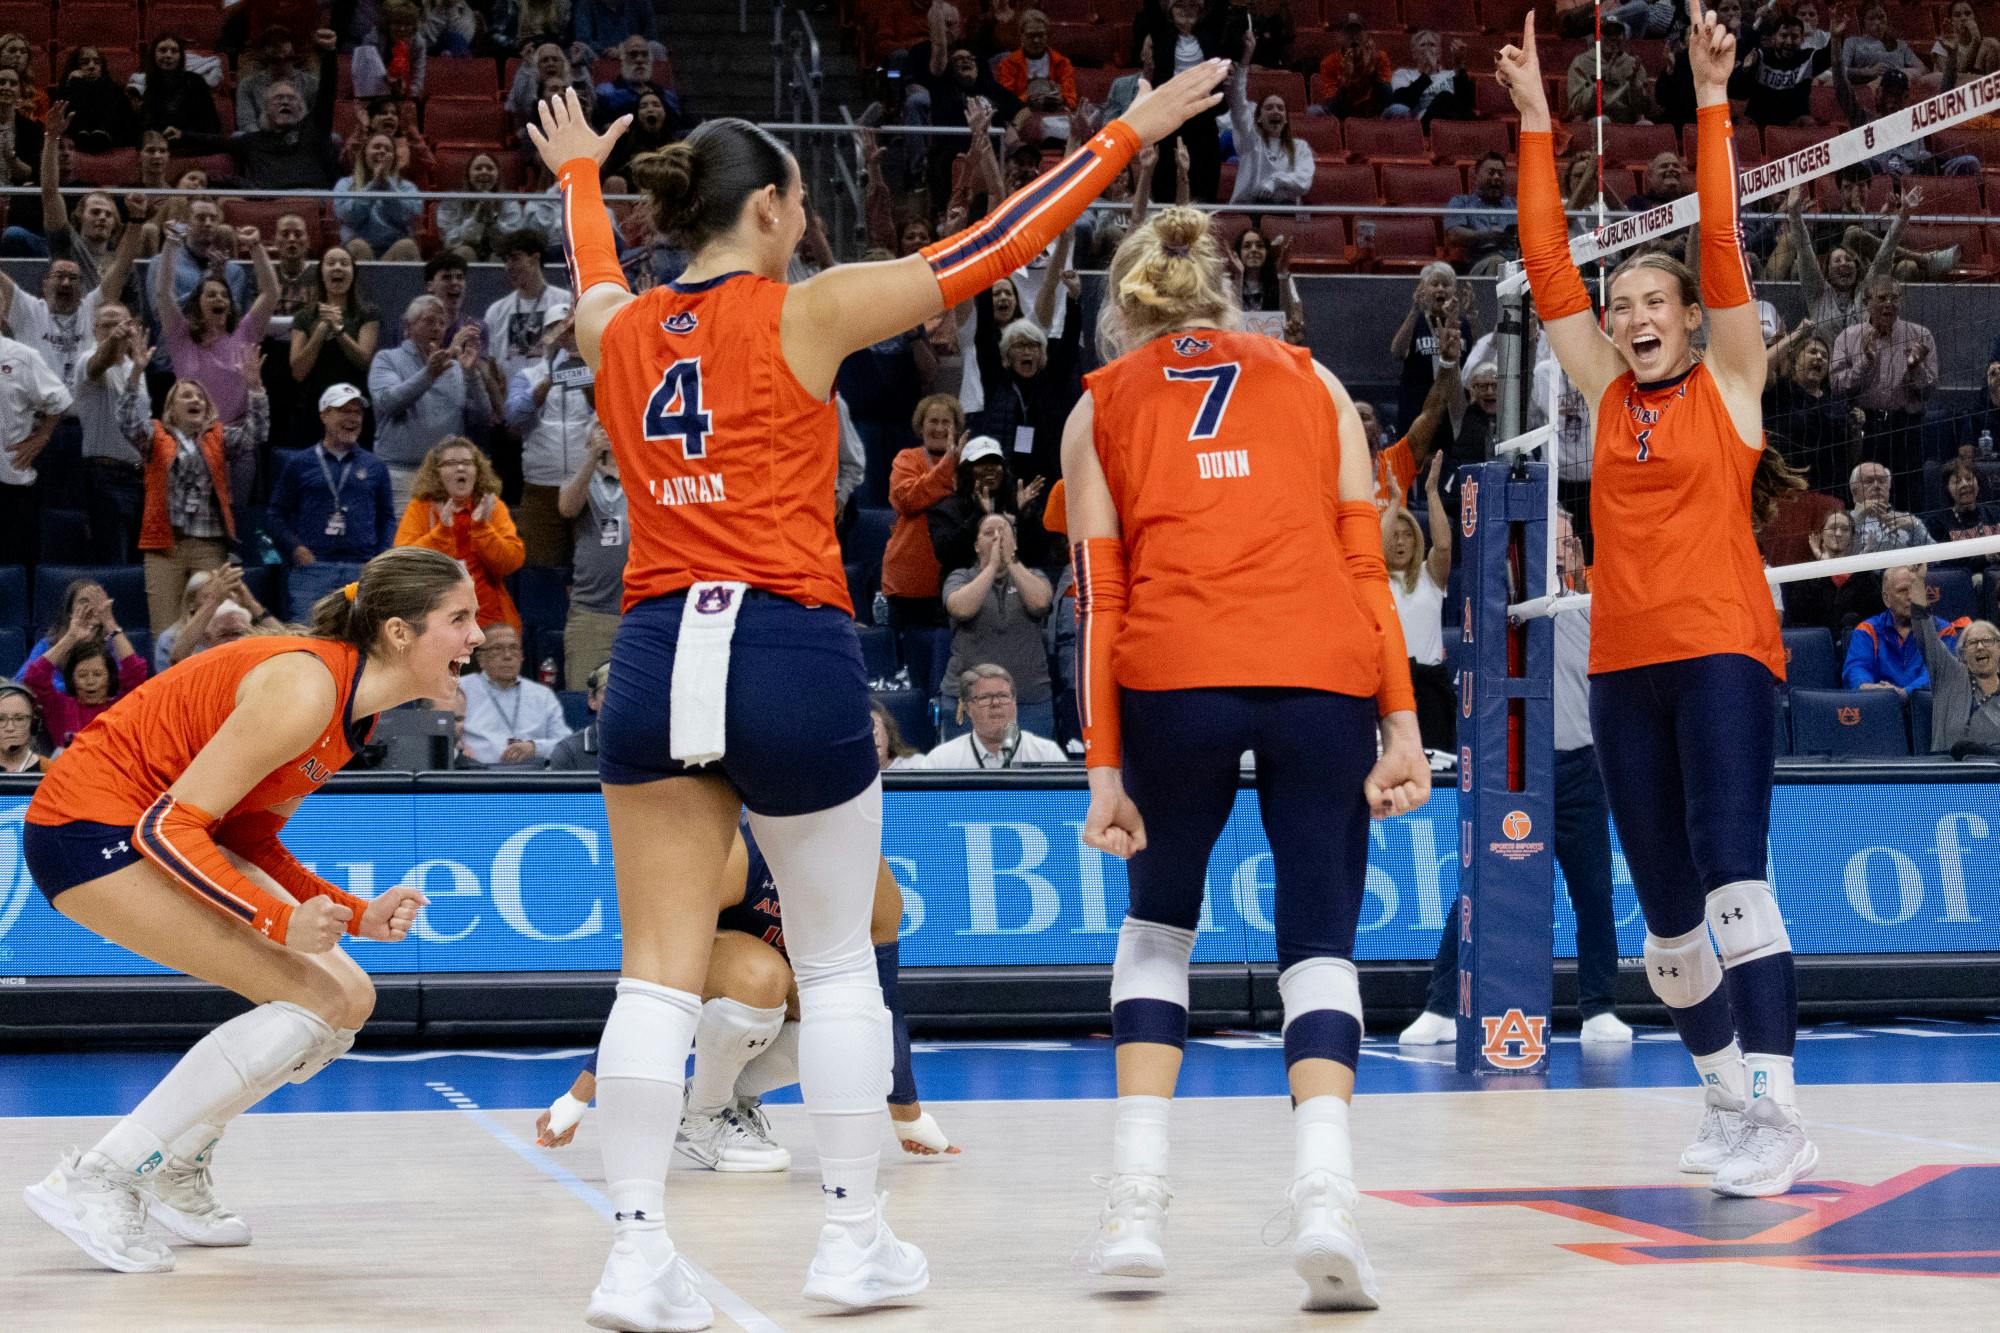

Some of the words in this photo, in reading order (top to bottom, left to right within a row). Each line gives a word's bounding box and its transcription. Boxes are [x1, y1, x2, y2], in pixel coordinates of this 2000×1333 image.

[1911, 88, 1967, 132] AUBURN
[1740, 159, 1786, 196] AUBURN
[1788, 143, 1830, 178] TIGERS
[1596, 218, 1636, 250] AUBURN
[1638, 204, 1674, 235] TIGERS
[643, 356, 713, 460] 4
[1163, 361, 1242, 441] 7
[1197, 450, 1250, 479] DUNN
[1636, 429, 1651, 462] 1
[1842, 811, 1990, 926] of
